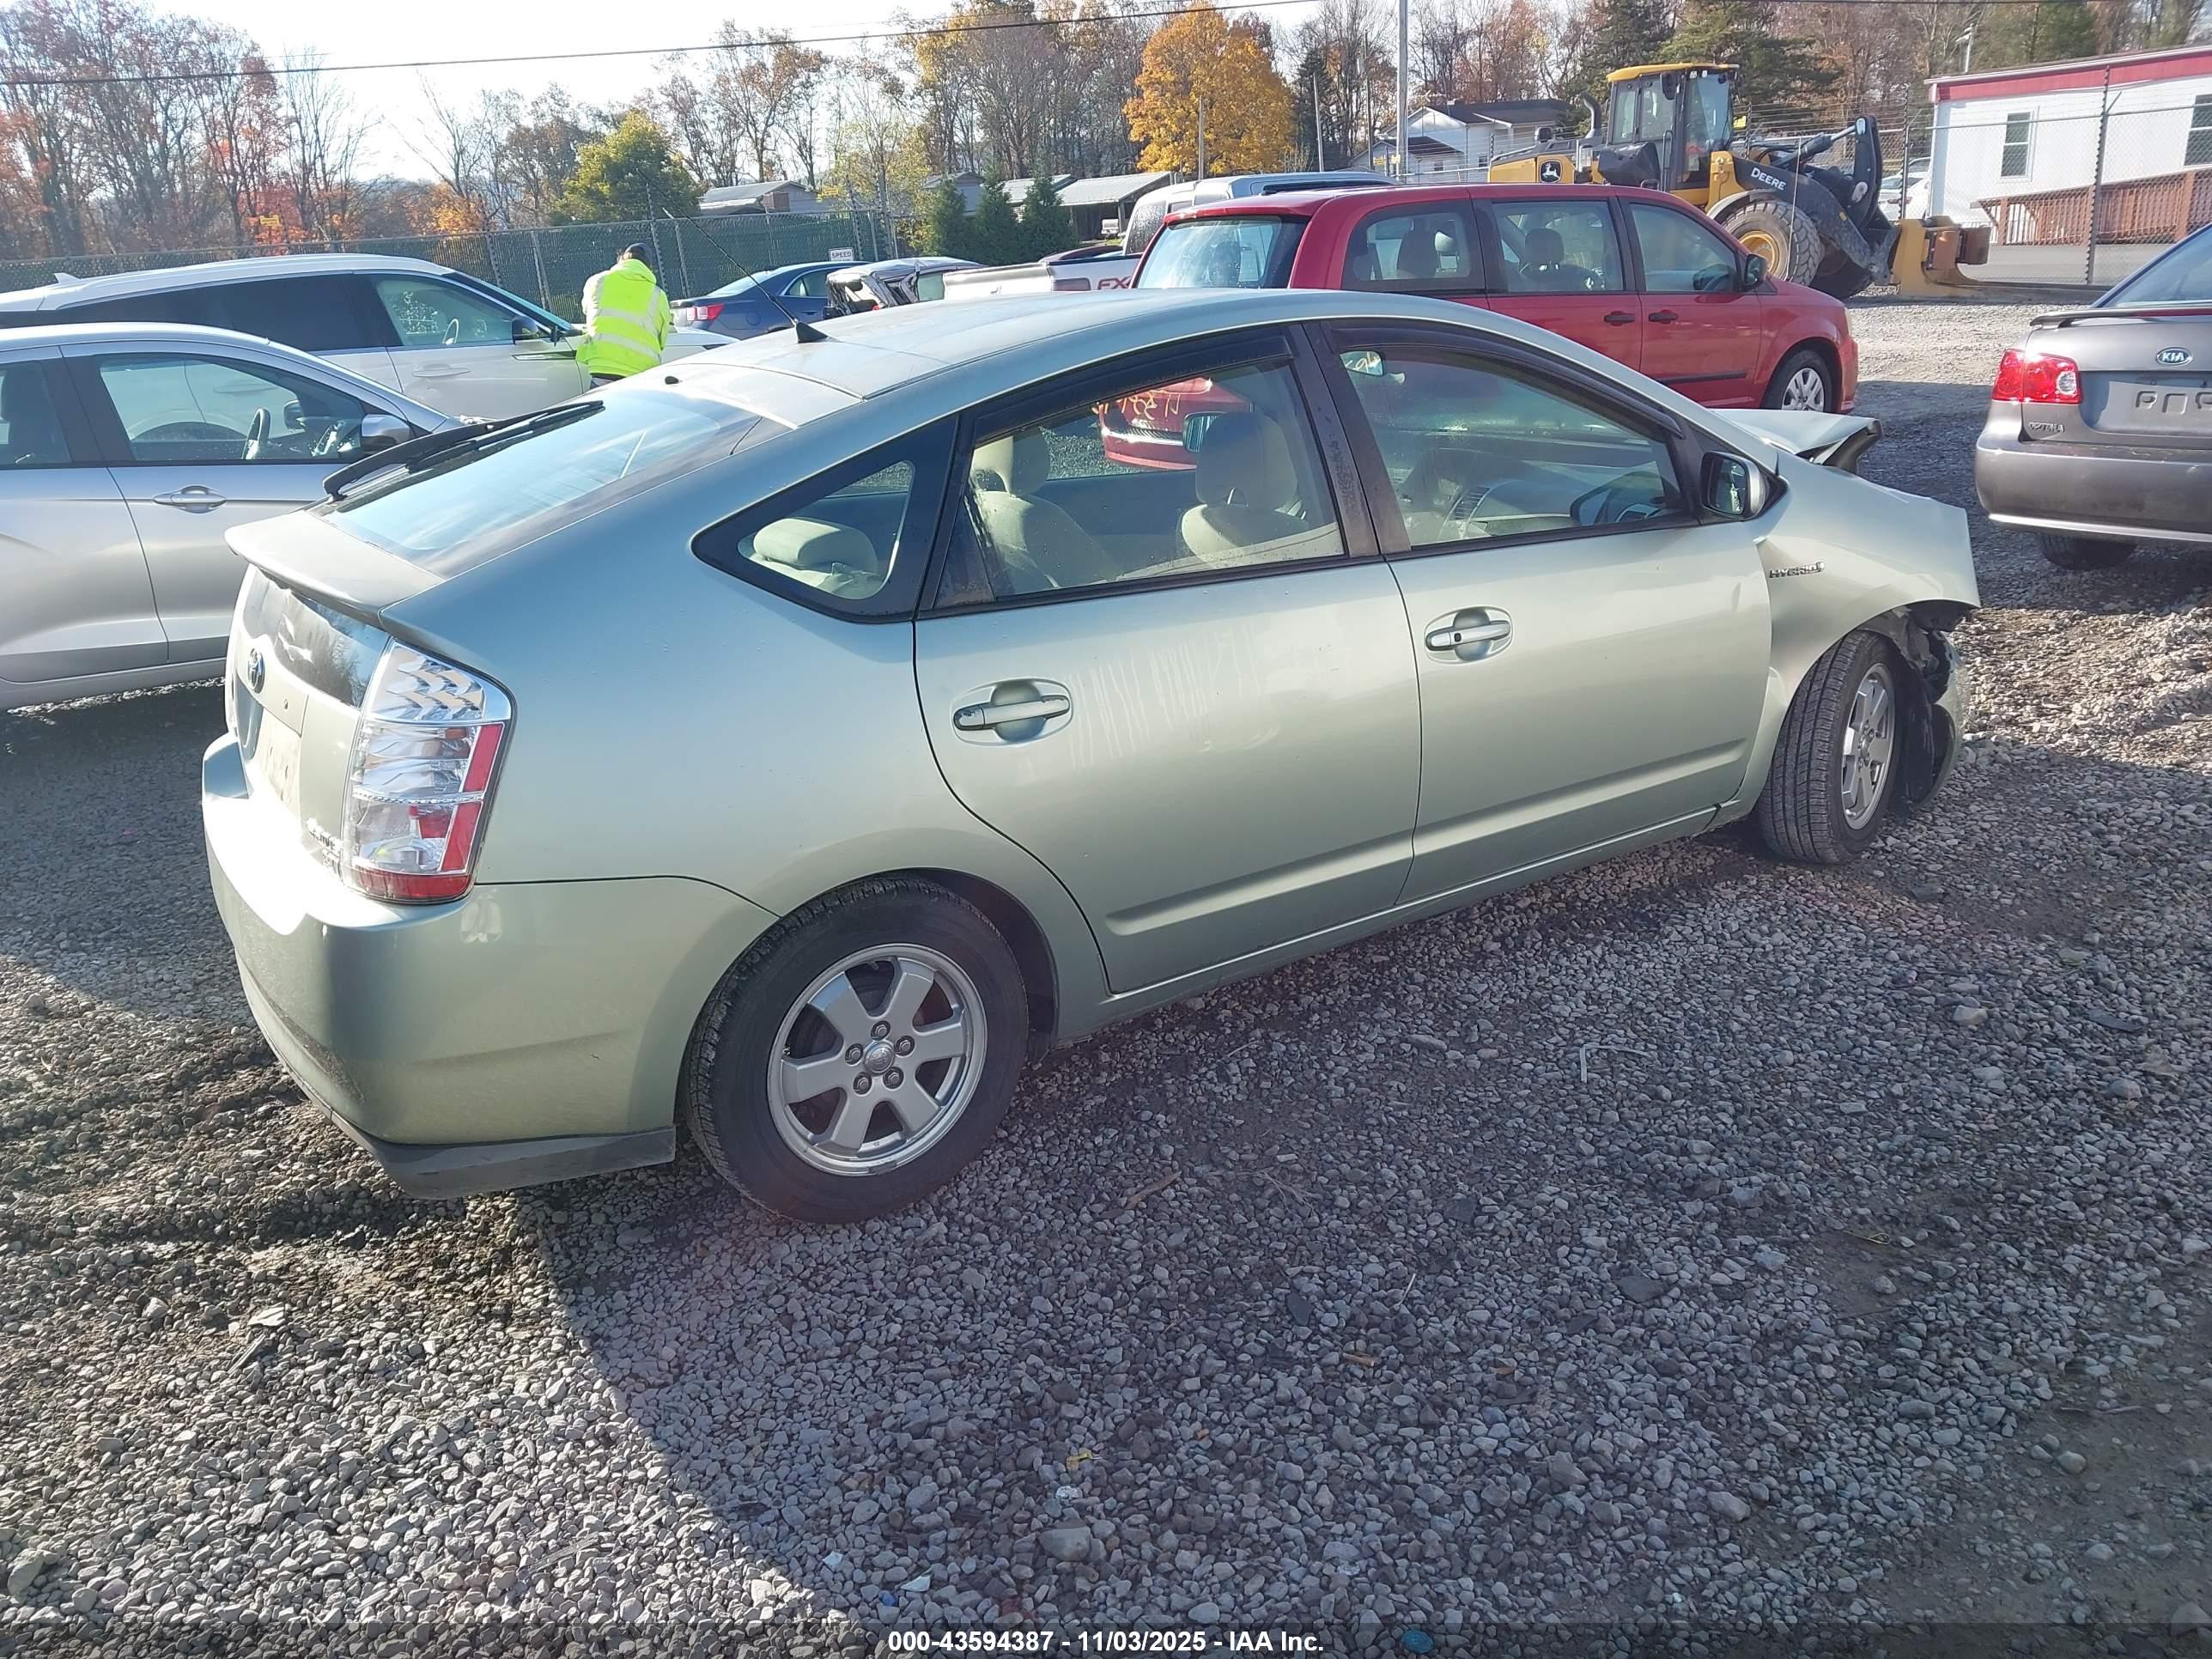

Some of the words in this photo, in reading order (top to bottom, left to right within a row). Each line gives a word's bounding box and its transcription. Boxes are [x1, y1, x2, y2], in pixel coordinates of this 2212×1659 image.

[1751, 167, 1786, 191] DEERE
[1097, 276, 1131, 290] FX
[2160, 351, 2185, 362] KIA
